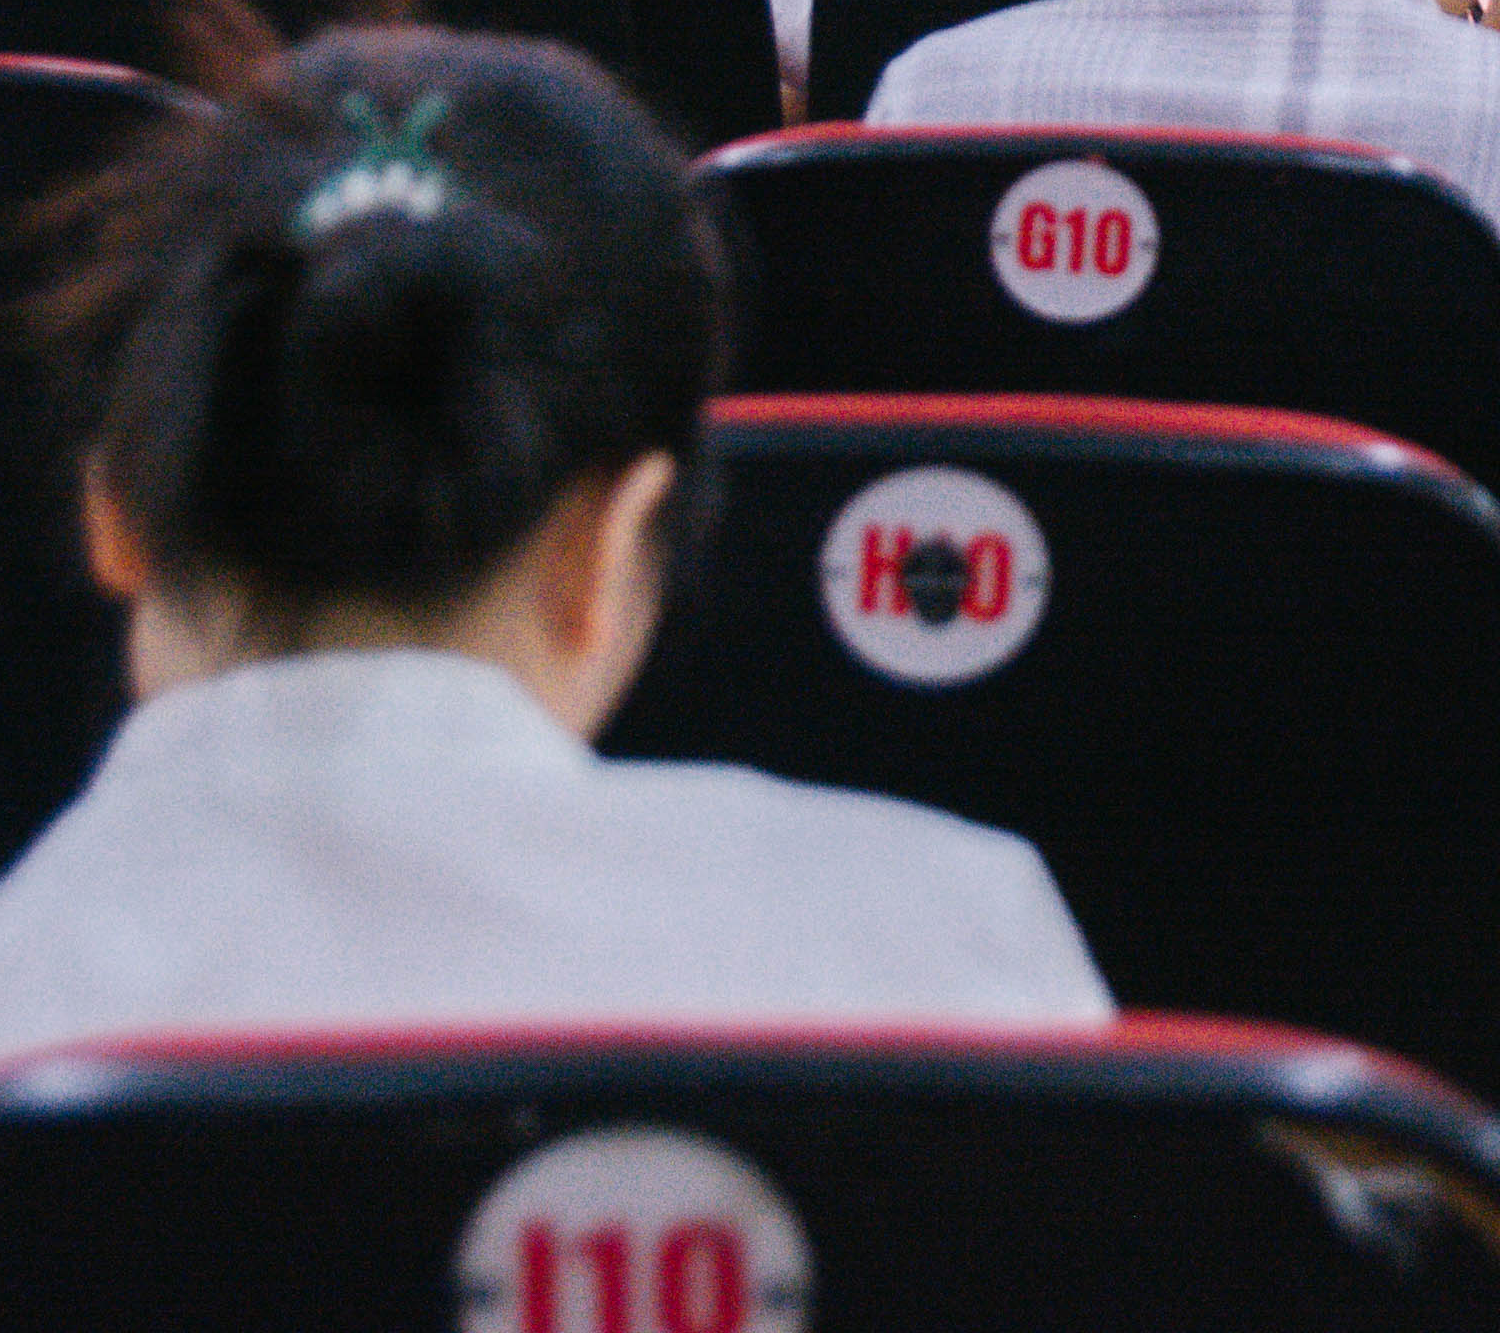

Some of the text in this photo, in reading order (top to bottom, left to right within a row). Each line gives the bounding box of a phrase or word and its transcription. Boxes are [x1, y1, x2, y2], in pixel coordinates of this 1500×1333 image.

[1016, 201, 1133, 278] G10
[861, 525, 1015, 623] H0
[518, 1220, 750, 1333] I10
